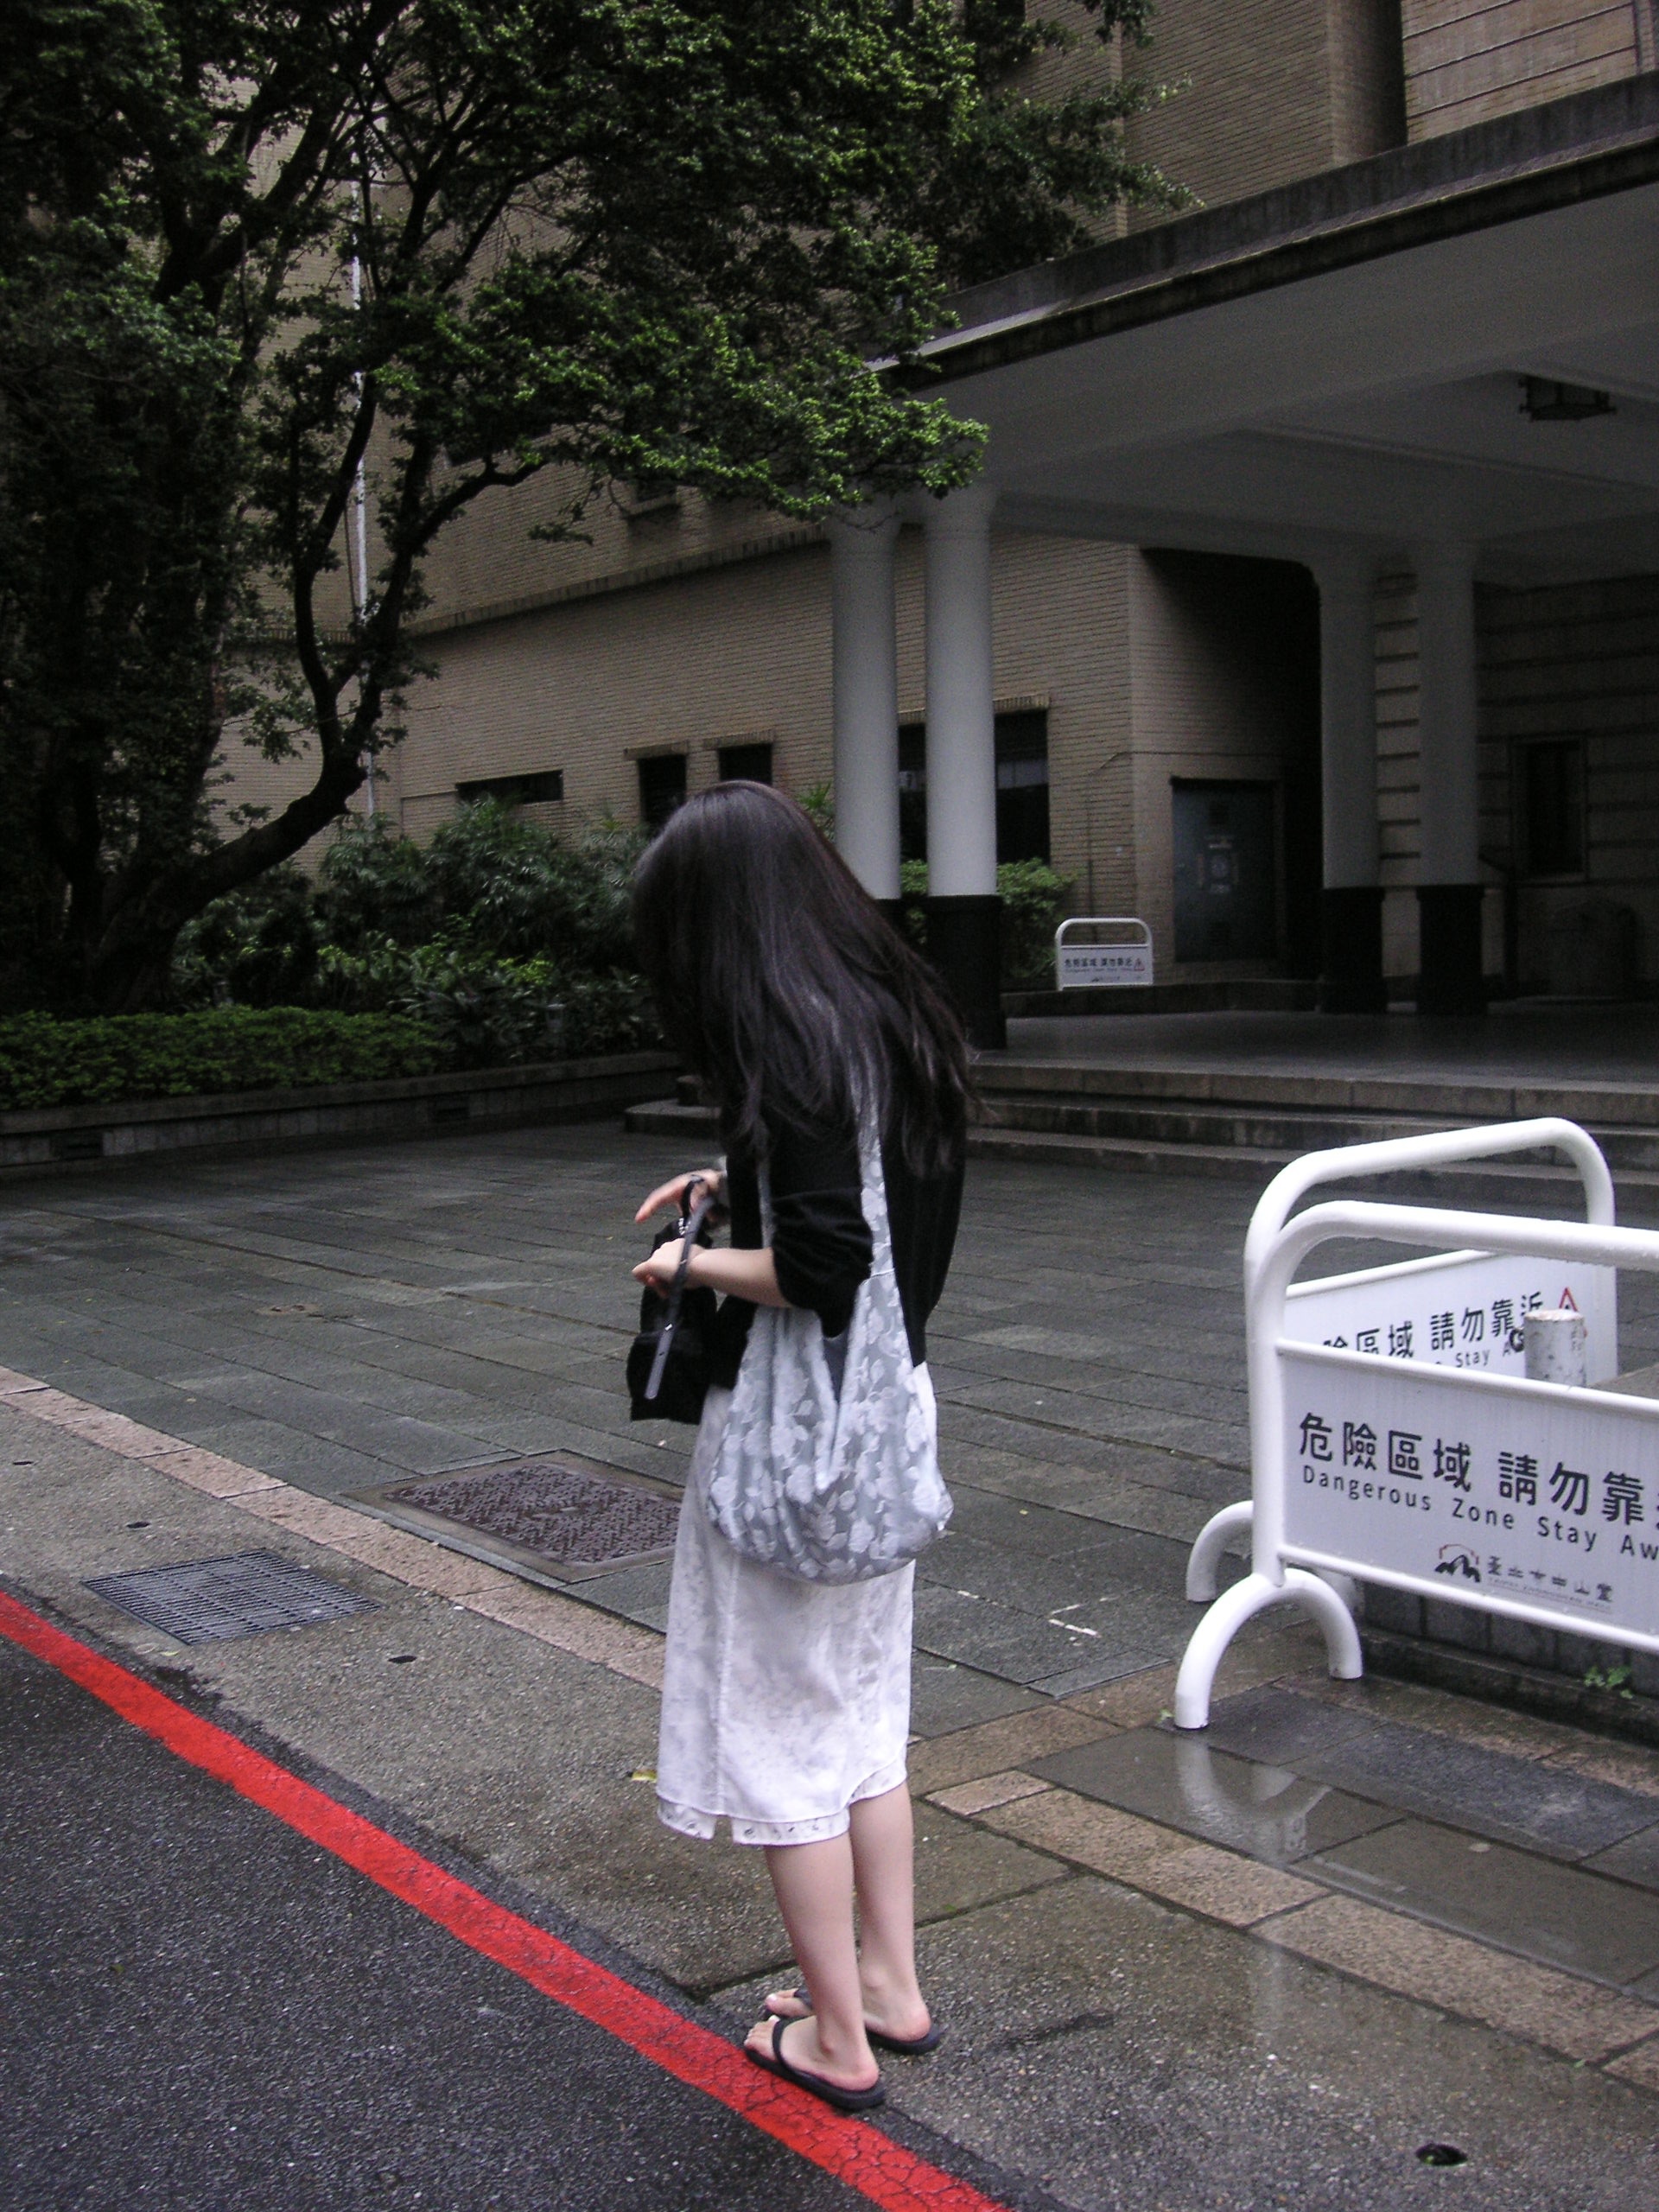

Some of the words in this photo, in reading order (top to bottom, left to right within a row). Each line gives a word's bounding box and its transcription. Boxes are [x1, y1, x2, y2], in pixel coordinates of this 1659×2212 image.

[1456, 1350, 1490, 1368] Stay
[1300, 1412, 1471, 1493] 危險區域
[1497, 1451, 1659, 1525] 請勿靠
[1303, 1465, 1431, 1511] Dangerous
[1452, 1497, 1515, 1529] Zone
[1537, 1516, 1597, 1553] Stay
